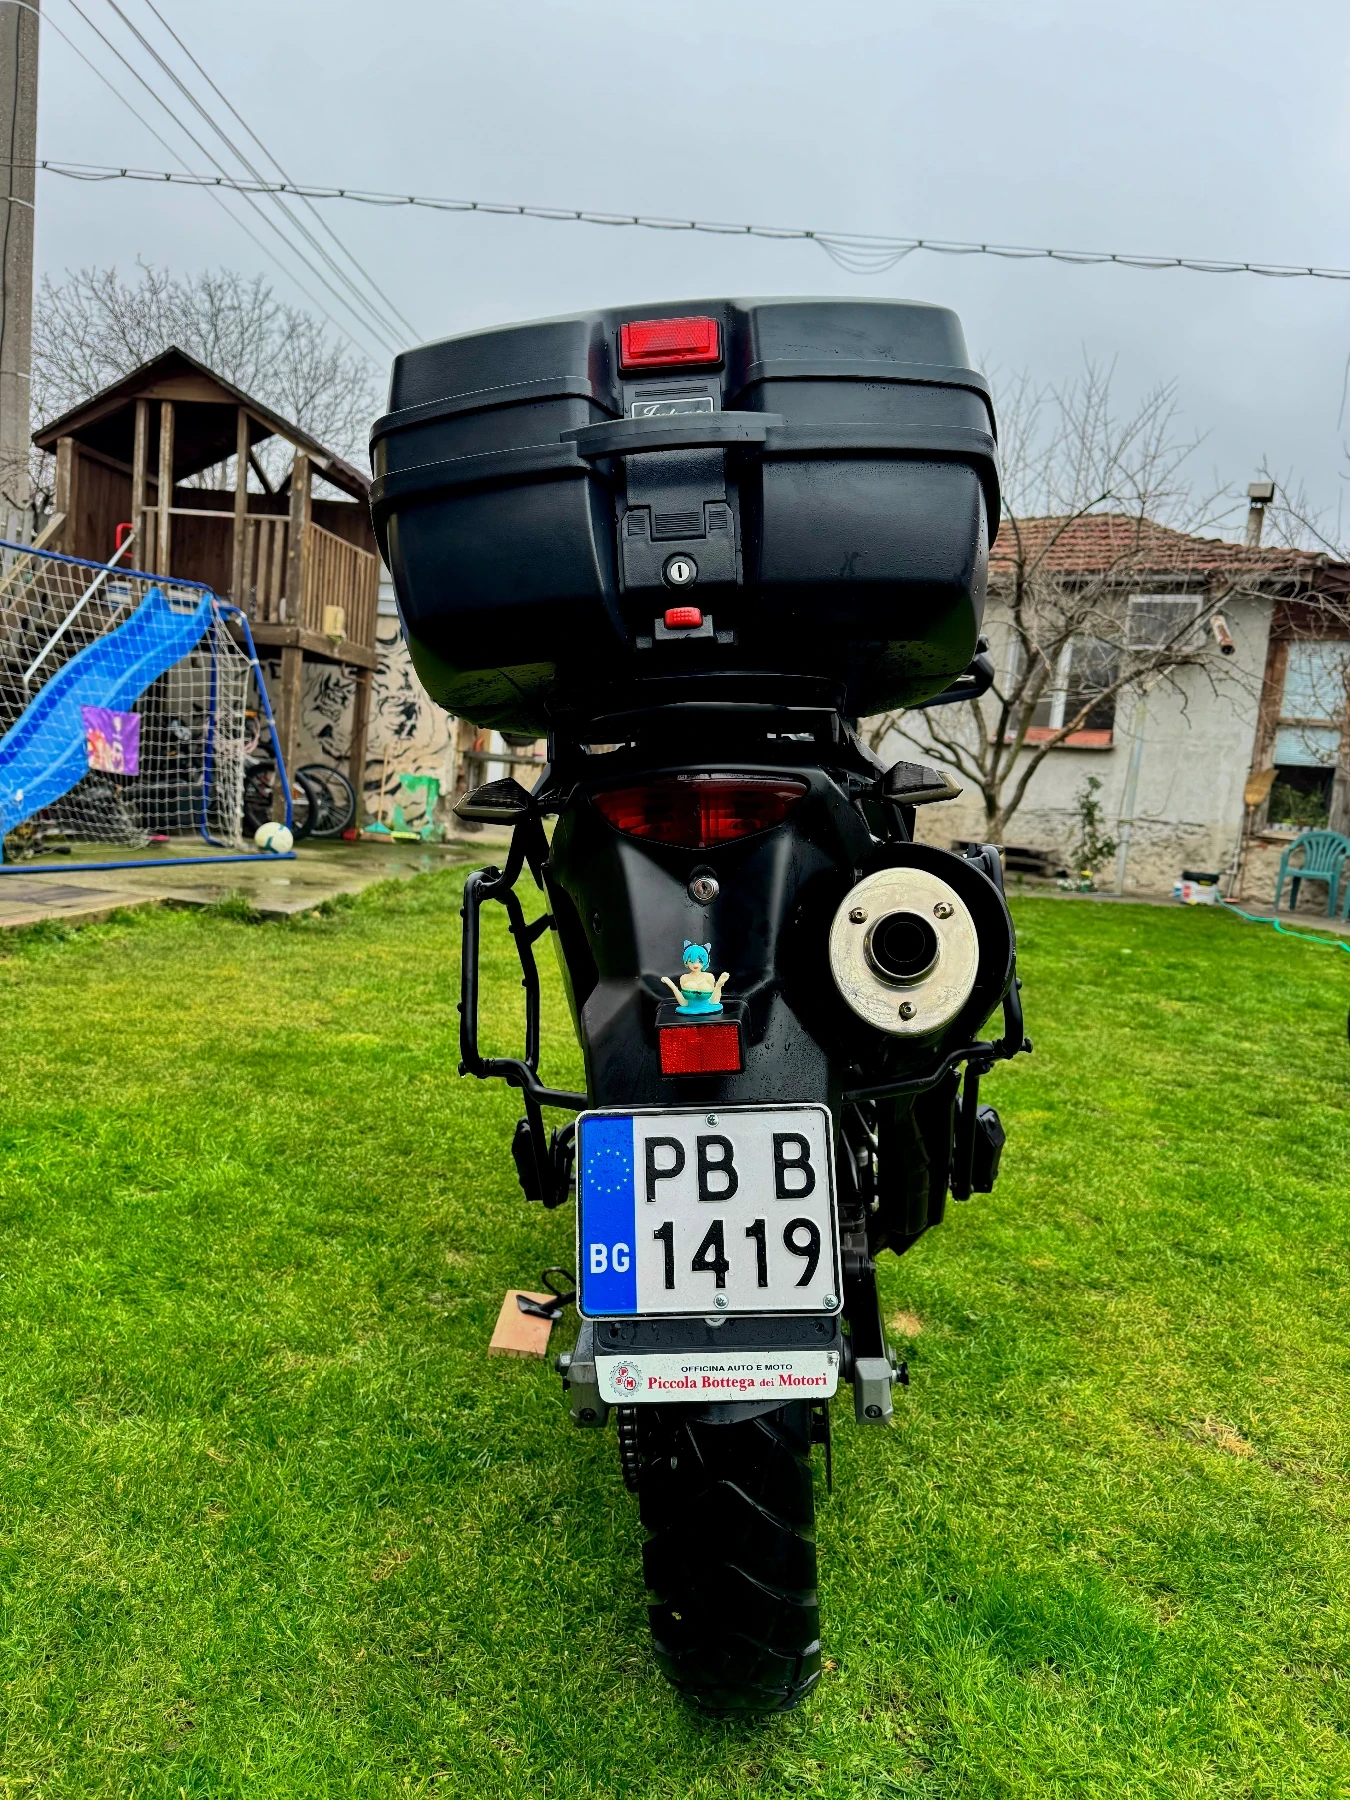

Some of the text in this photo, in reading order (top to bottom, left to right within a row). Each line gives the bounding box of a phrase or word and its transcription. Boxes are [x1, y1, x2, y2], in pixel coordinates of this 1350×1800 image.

[644, 1132, 816, 1203] PB B
[589, 1242, 631, 1274] BG
[653, 1217, 822, 1290] 1419
[647, 1372, 828, 1391] Piccola Bottega dei Motori
[765, 1363, 793, 1371] MOTO
